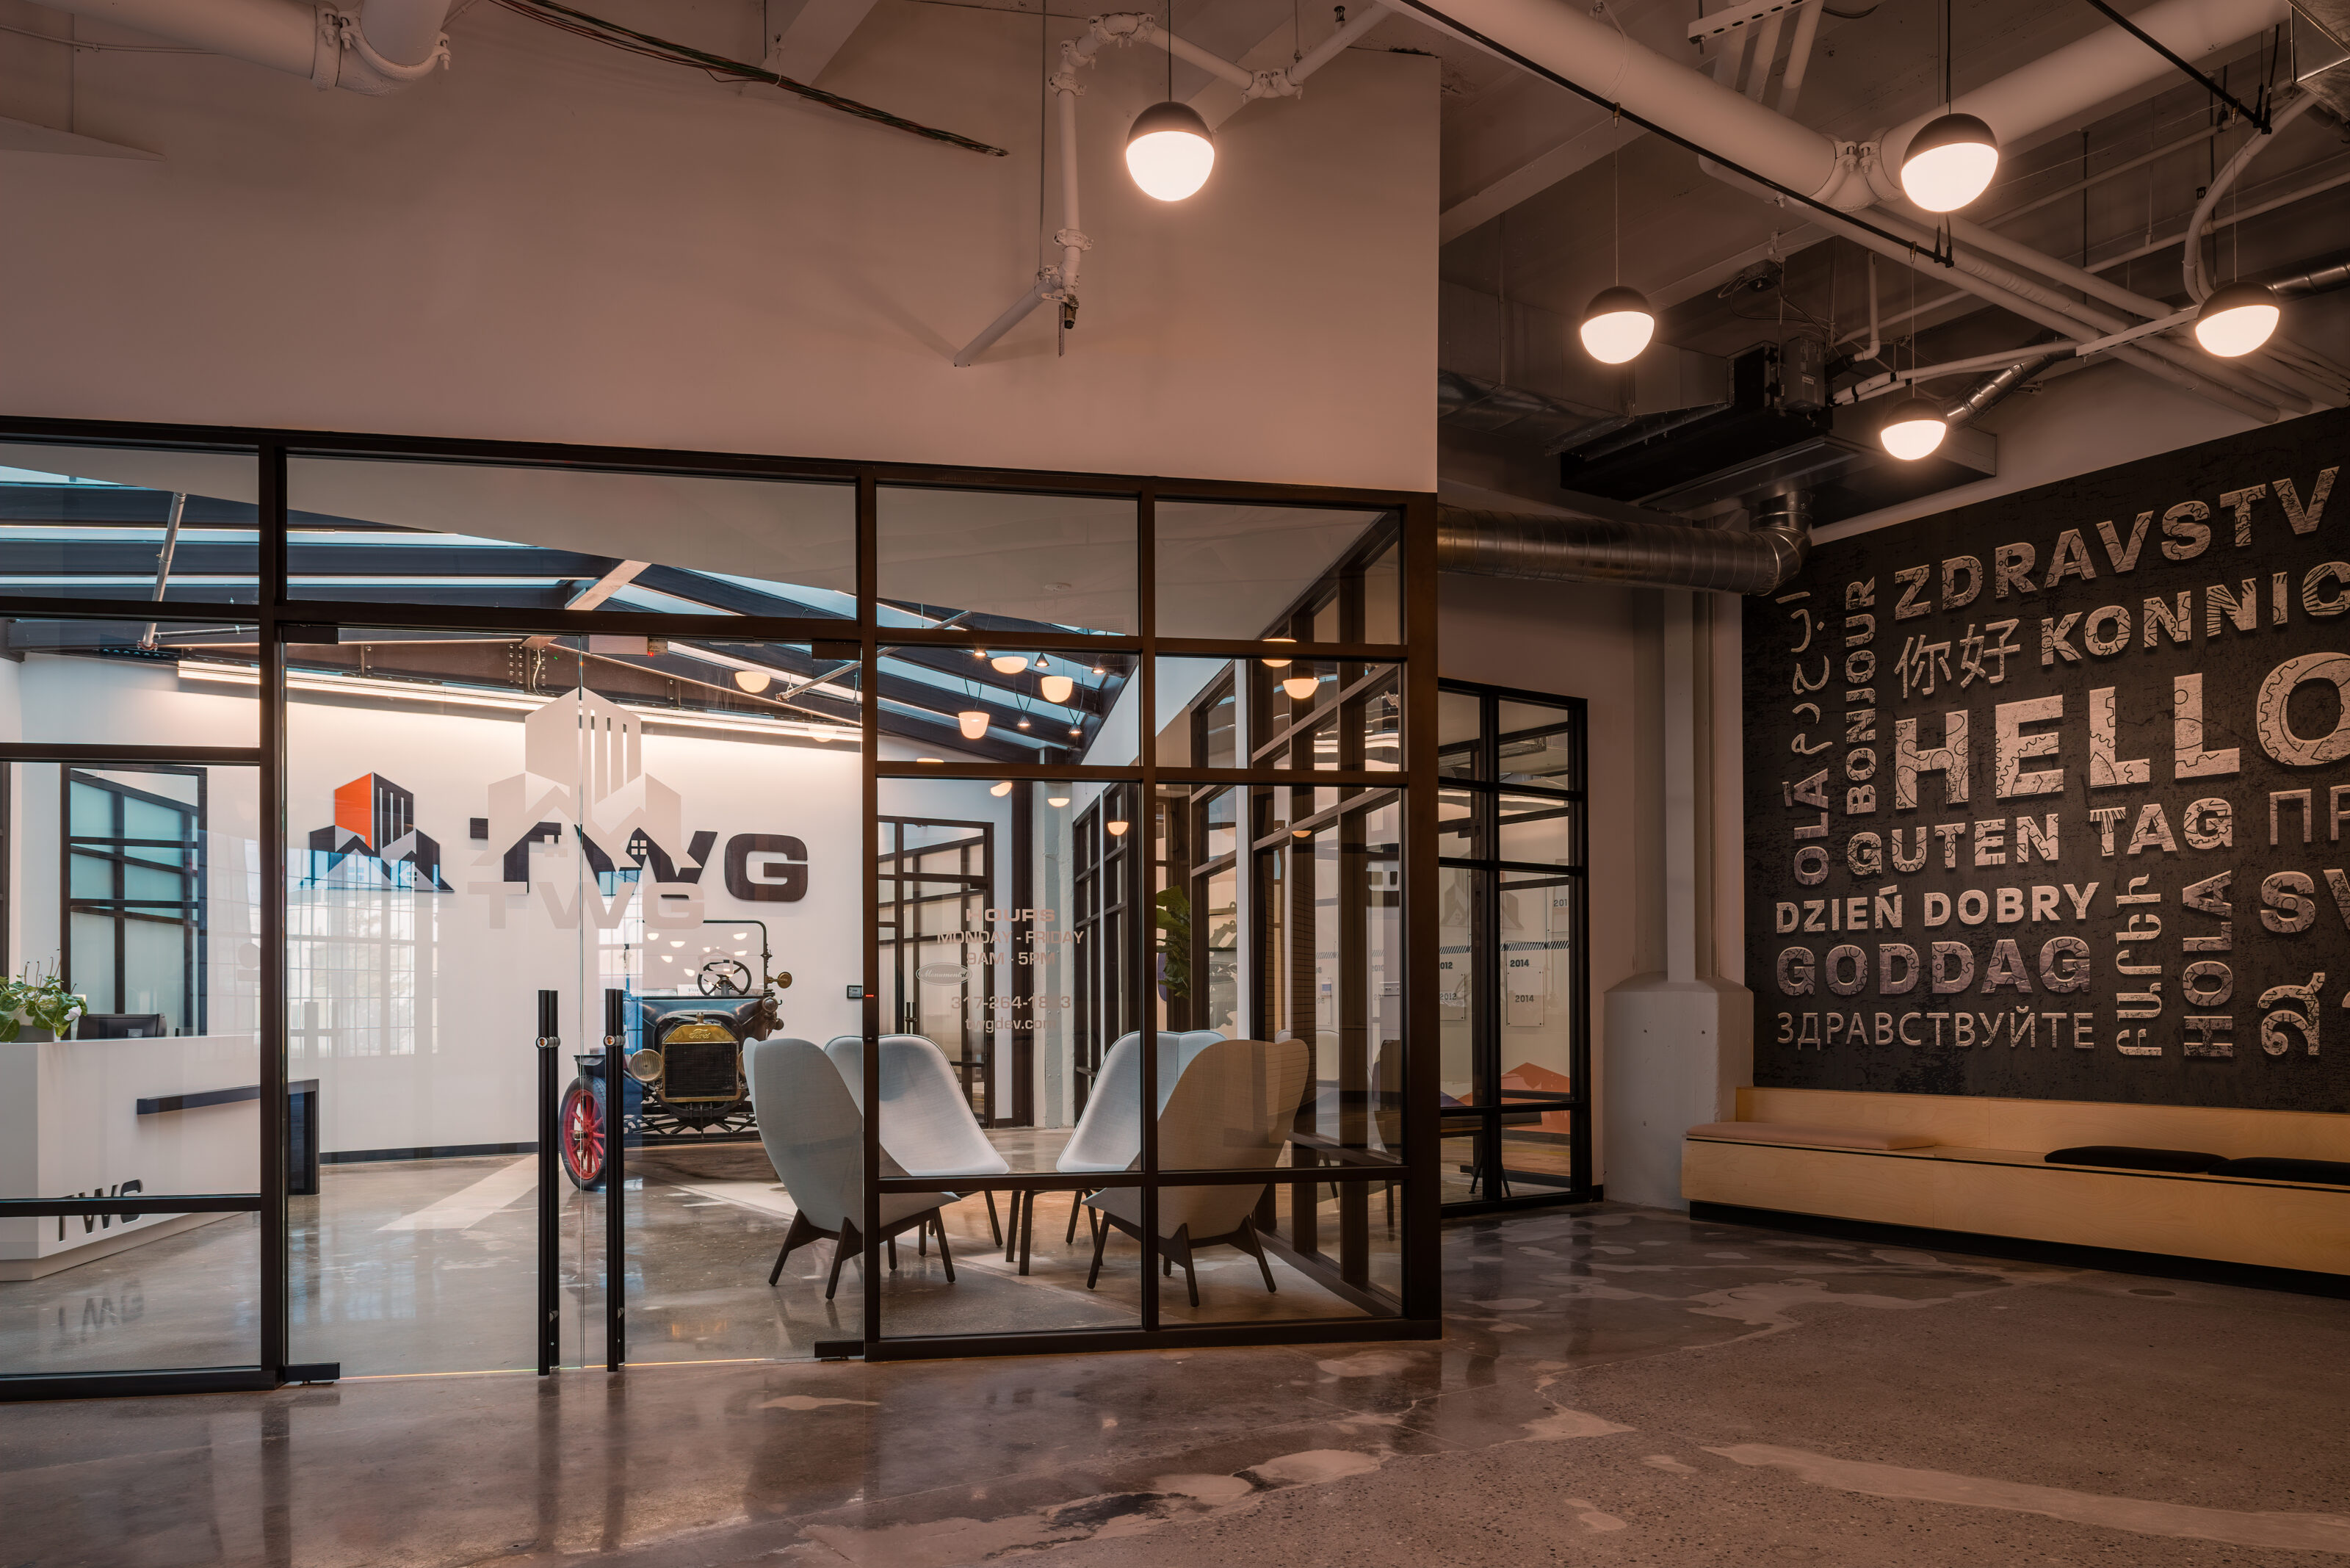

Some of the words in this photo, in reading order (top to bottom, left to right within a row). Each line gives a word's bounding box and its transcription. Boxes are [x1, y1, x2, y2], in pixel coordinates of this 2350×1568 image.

[1895, 466, 2340, 621] ZDRAVSTV
[2041, 561, 2350, 666] KONNIC
[1894, 618, 2021, 699] 你好
[1845, 577, 1876, 814] BONJOUR
[1895, 652, 2350, 810] HELLO
[1846, 813, 2059, 876] GUTEN
[2090, 798, 2232, 857] TAG
[467, 881, 705, 930] TWG
[966, 908, 1055, 922] HOURS
[1553, 899, 1569, 907] 201
[1776, 884, 1903, 933] DZIEŃ
[1924, 881, 2100, 927] DOBRY
[937, 931, 1013, 944] MONDAY
[1025, 931, 1084, 944] FRIDAY
[967, 953, 1004, 965] 9AM
[1019, 953, 1055, 965] 5PM
[1510, 959, 1530, 968] 2014
[1776, 936, 2091, 996] GODDAG
[2182, 870, 2233, 1057] HOLA
[951, 996, 1071, 1009] 317-264-183
[965, 1017, 1058, 1033] twgdev.com
[689, 1028, 712, 1039] Ford
[1777, 1005, 2094, 1051] ЗДРАВСТВУЙТЕ
